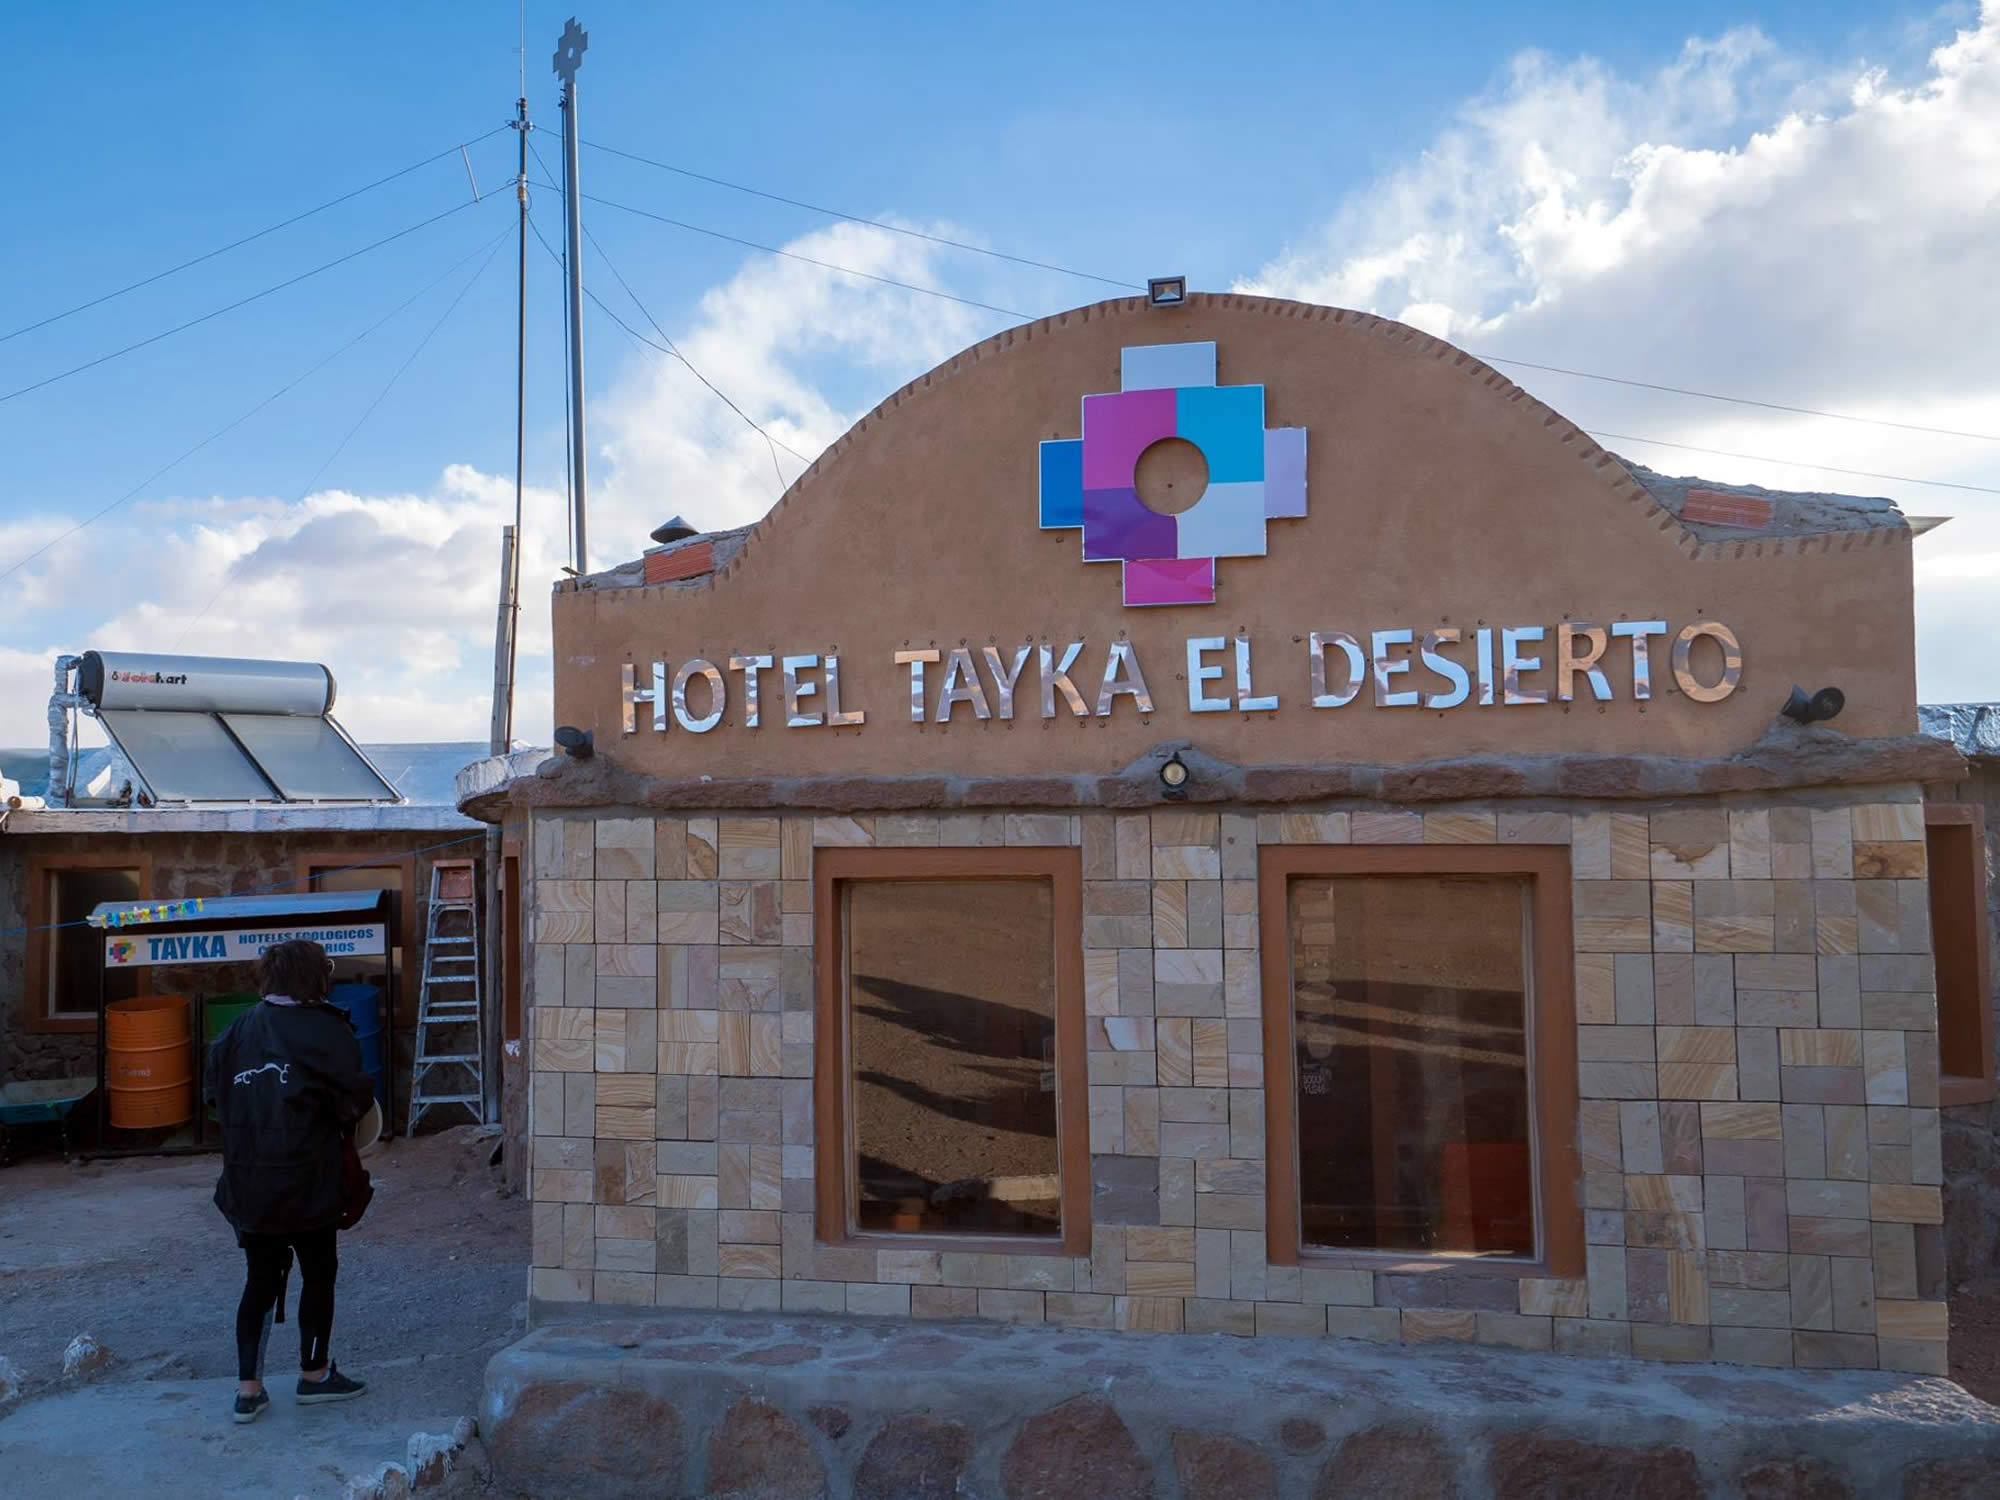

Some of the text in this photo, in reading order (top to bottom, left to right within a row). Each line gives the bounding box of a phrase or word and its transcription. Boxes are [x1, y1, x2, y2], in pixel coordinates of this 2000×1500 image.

[621, 619, 1742, 733] HOTEL TAYKA EL DESIERTO
[148, 934, 227, 961] TAYKA
[238, 931, 293, 945] HOTELES
